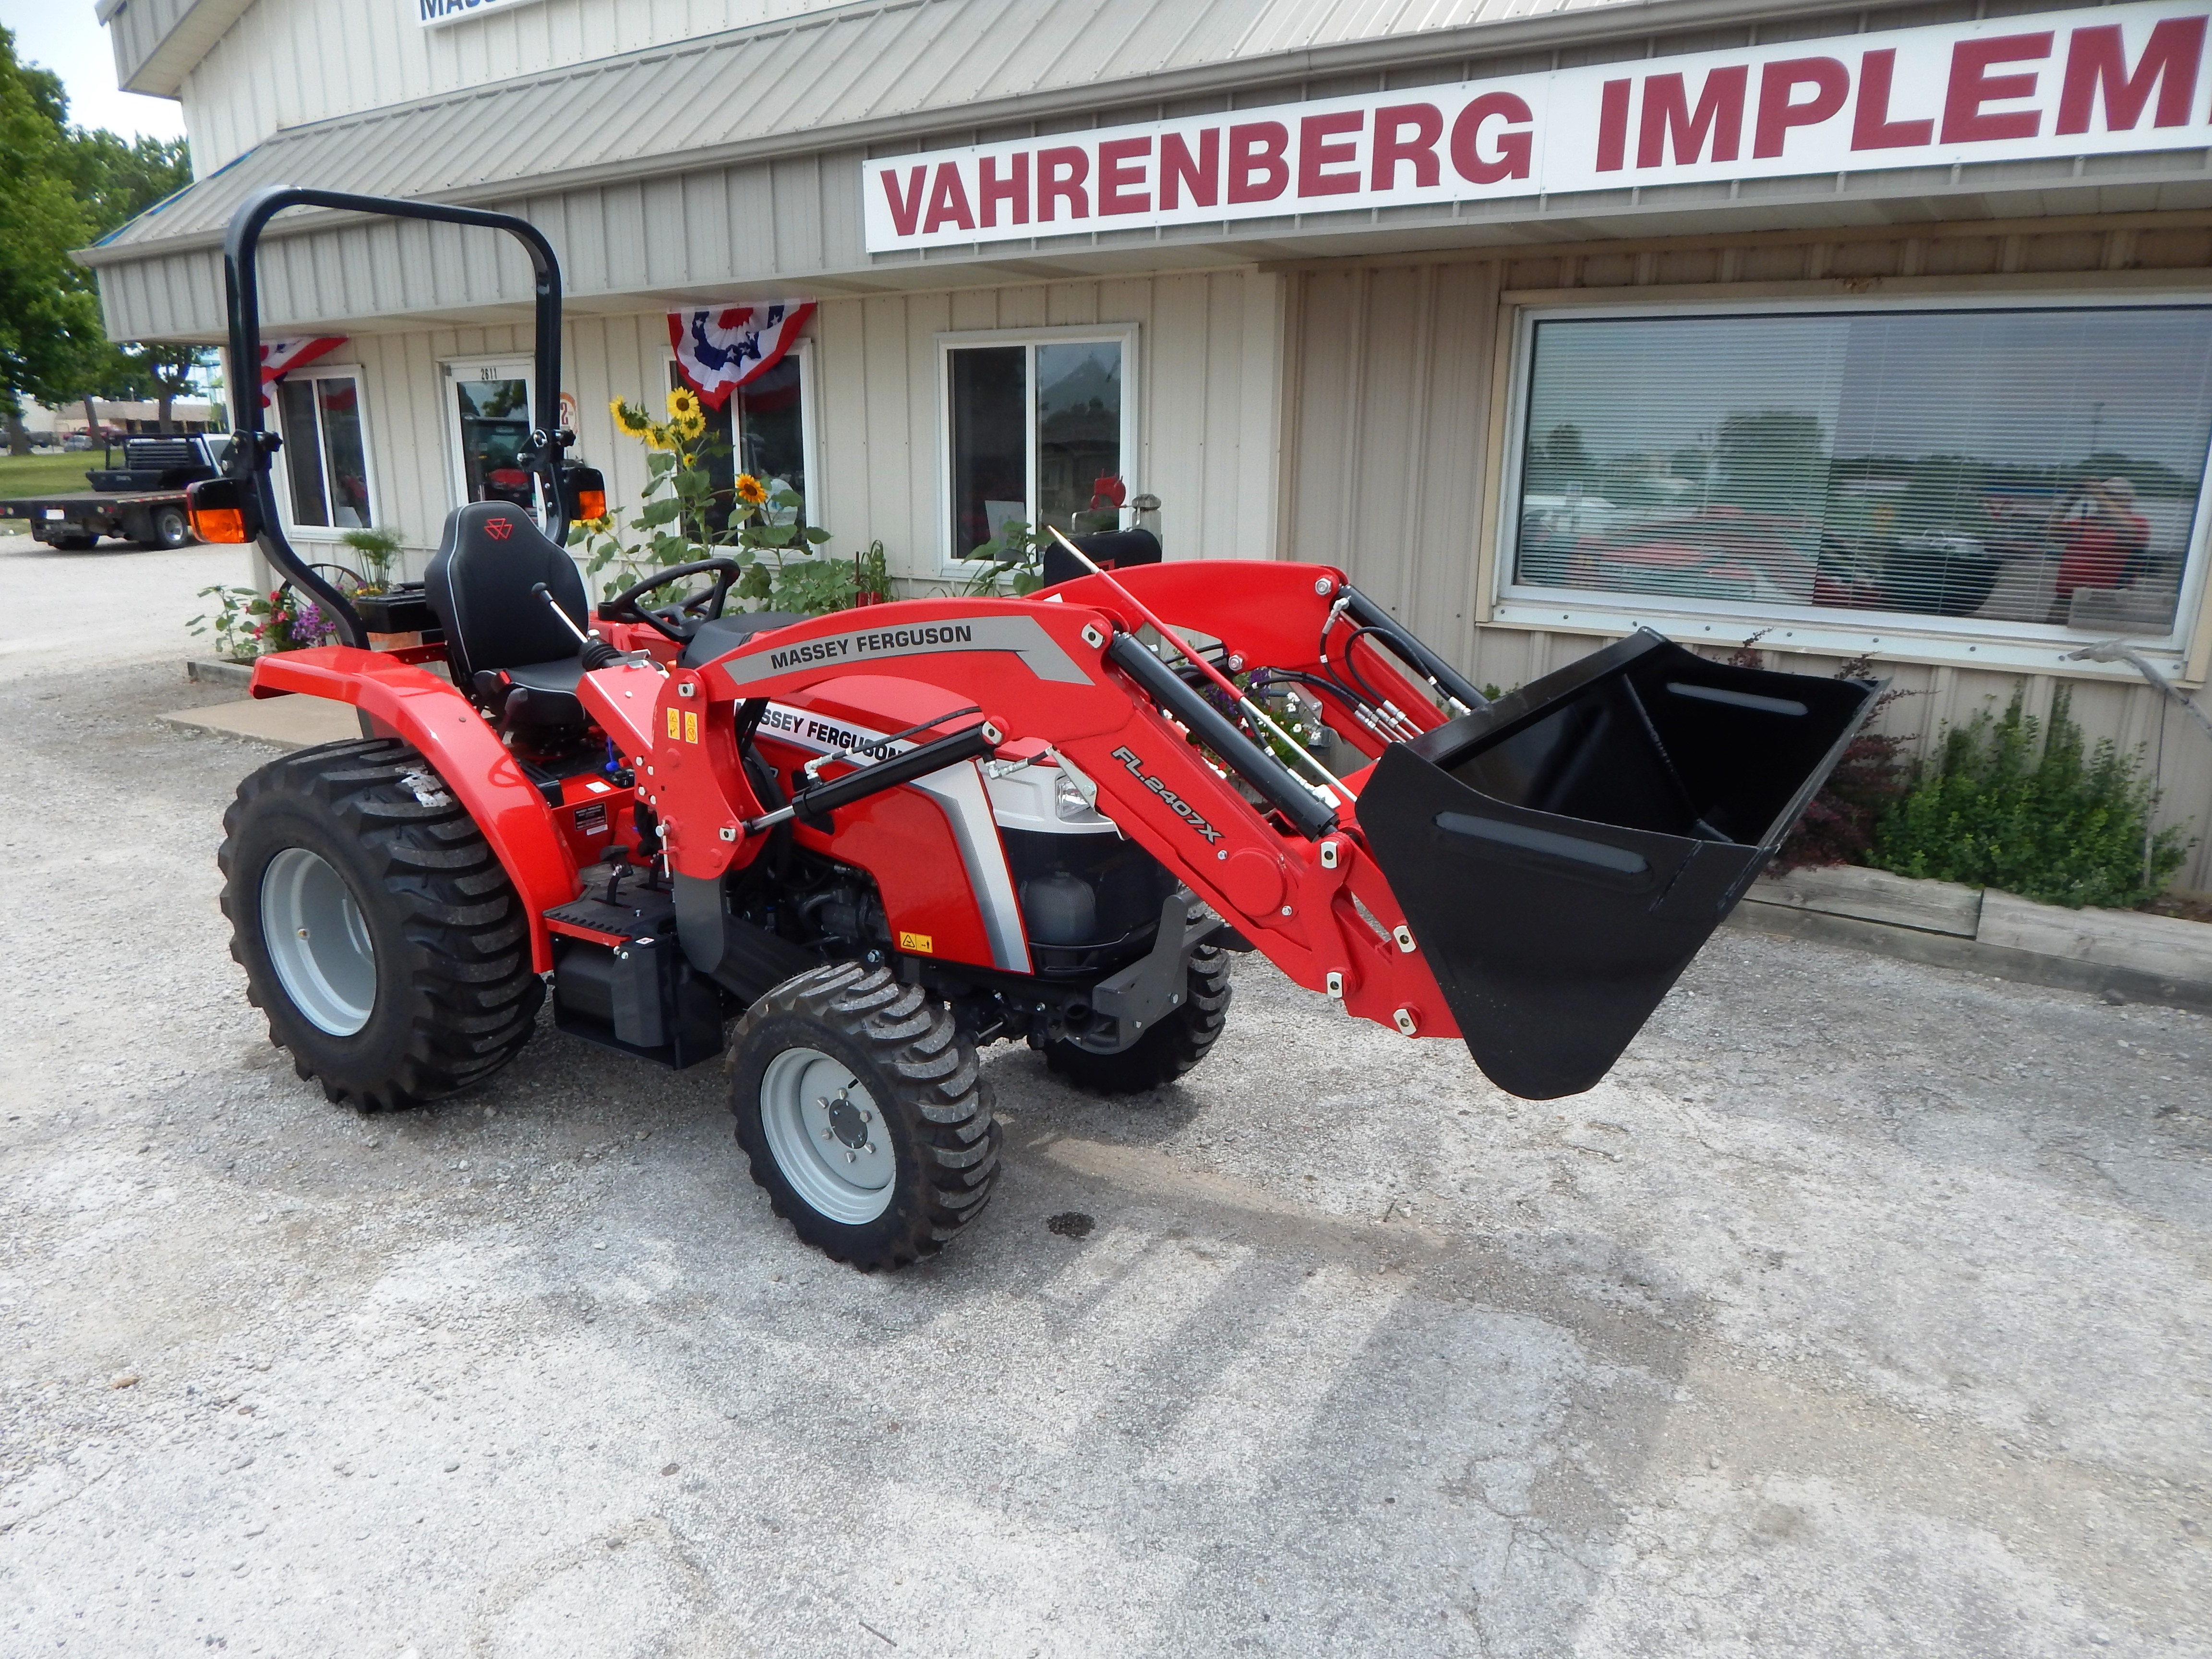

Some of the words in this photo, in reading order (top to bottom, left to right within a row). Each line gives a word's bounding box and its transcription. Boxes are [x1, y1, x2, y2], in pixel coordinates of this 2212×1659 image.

[881, 92, 1533, 235] VAHRENBERG
[1595, 15, 2212, 172] IMPLEM
[481, 367, 498, 380] 2611
[770, 638, 848, 669] MASSEY
[856, 625, 972, 652] FERGUSON
[1111, 745, 1225, 845] FL.2407X
